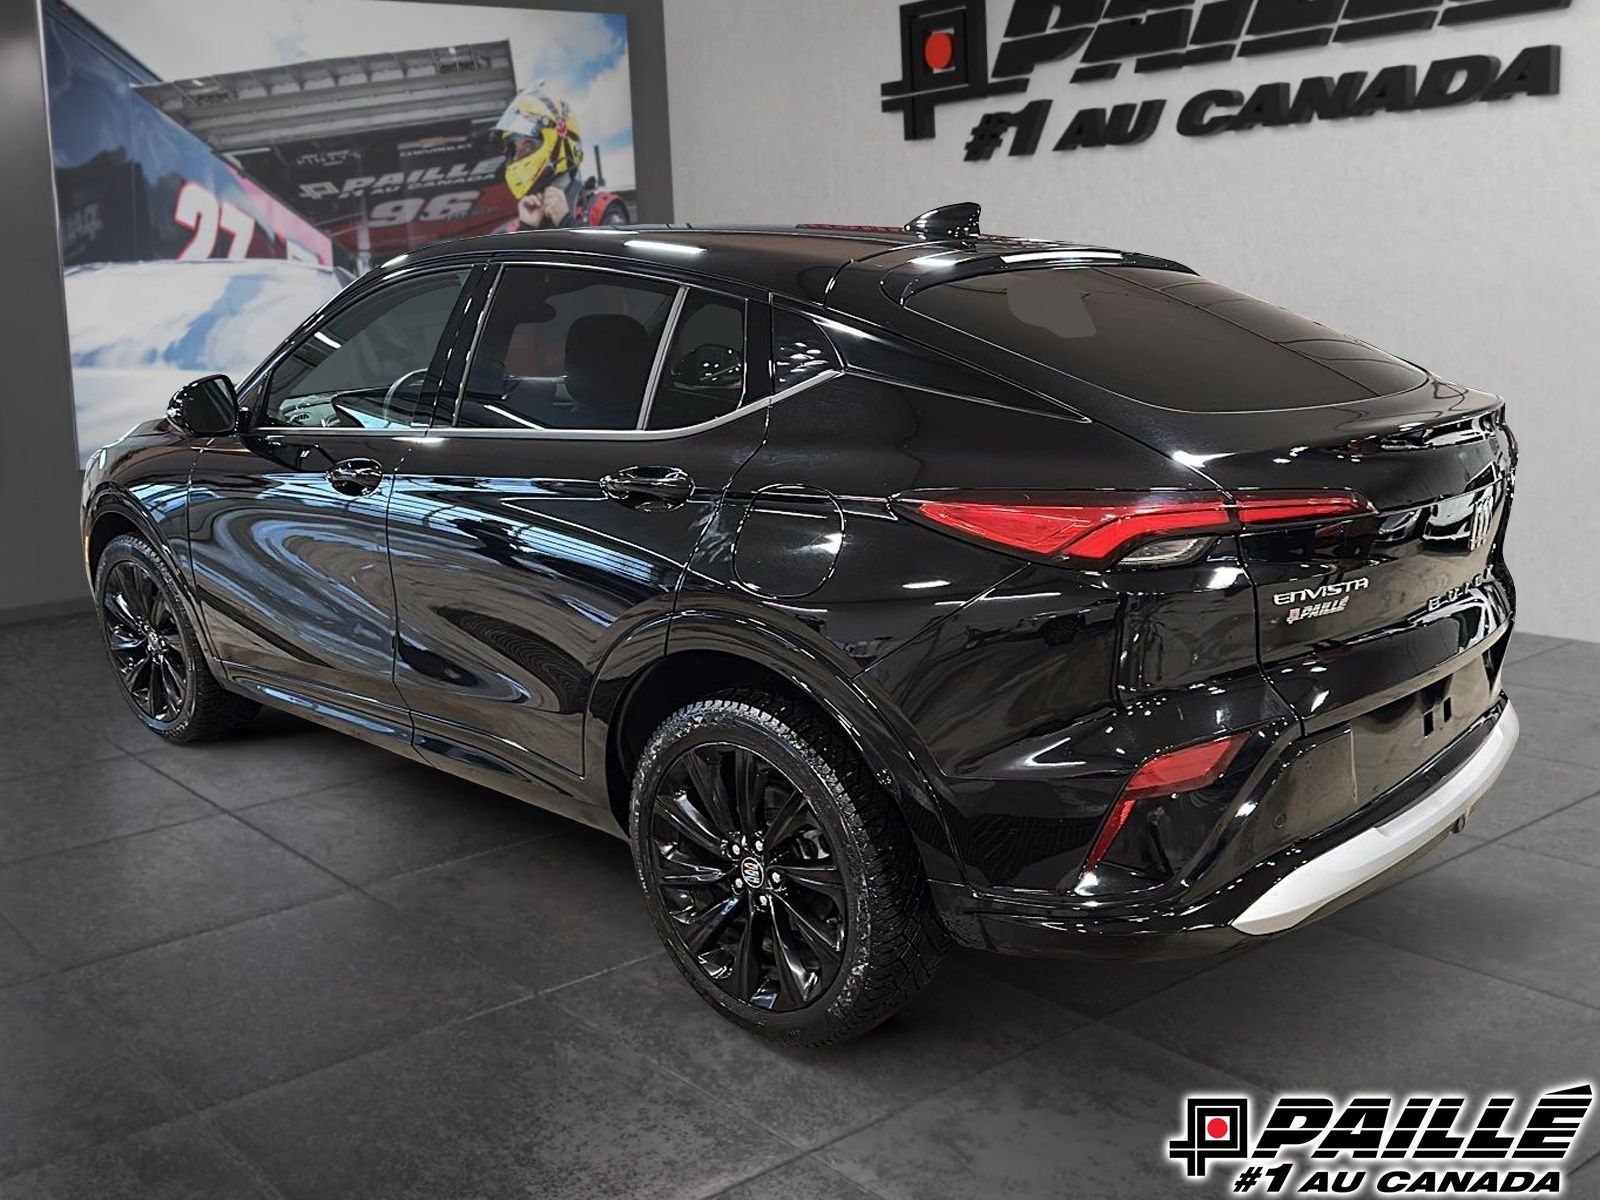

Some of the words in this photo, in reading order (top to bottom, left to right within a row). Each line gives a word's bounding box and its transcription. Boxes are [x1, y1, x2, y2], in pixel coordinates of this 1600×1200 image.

[963, 99, 1053, 161] #1
[1053, 100, 1166, 151] AU
[1176, 44, 1562, 137] CANADA
[367, 190, 481, 228] 96
[1273, 577, 1370, 606] ENVISTA
